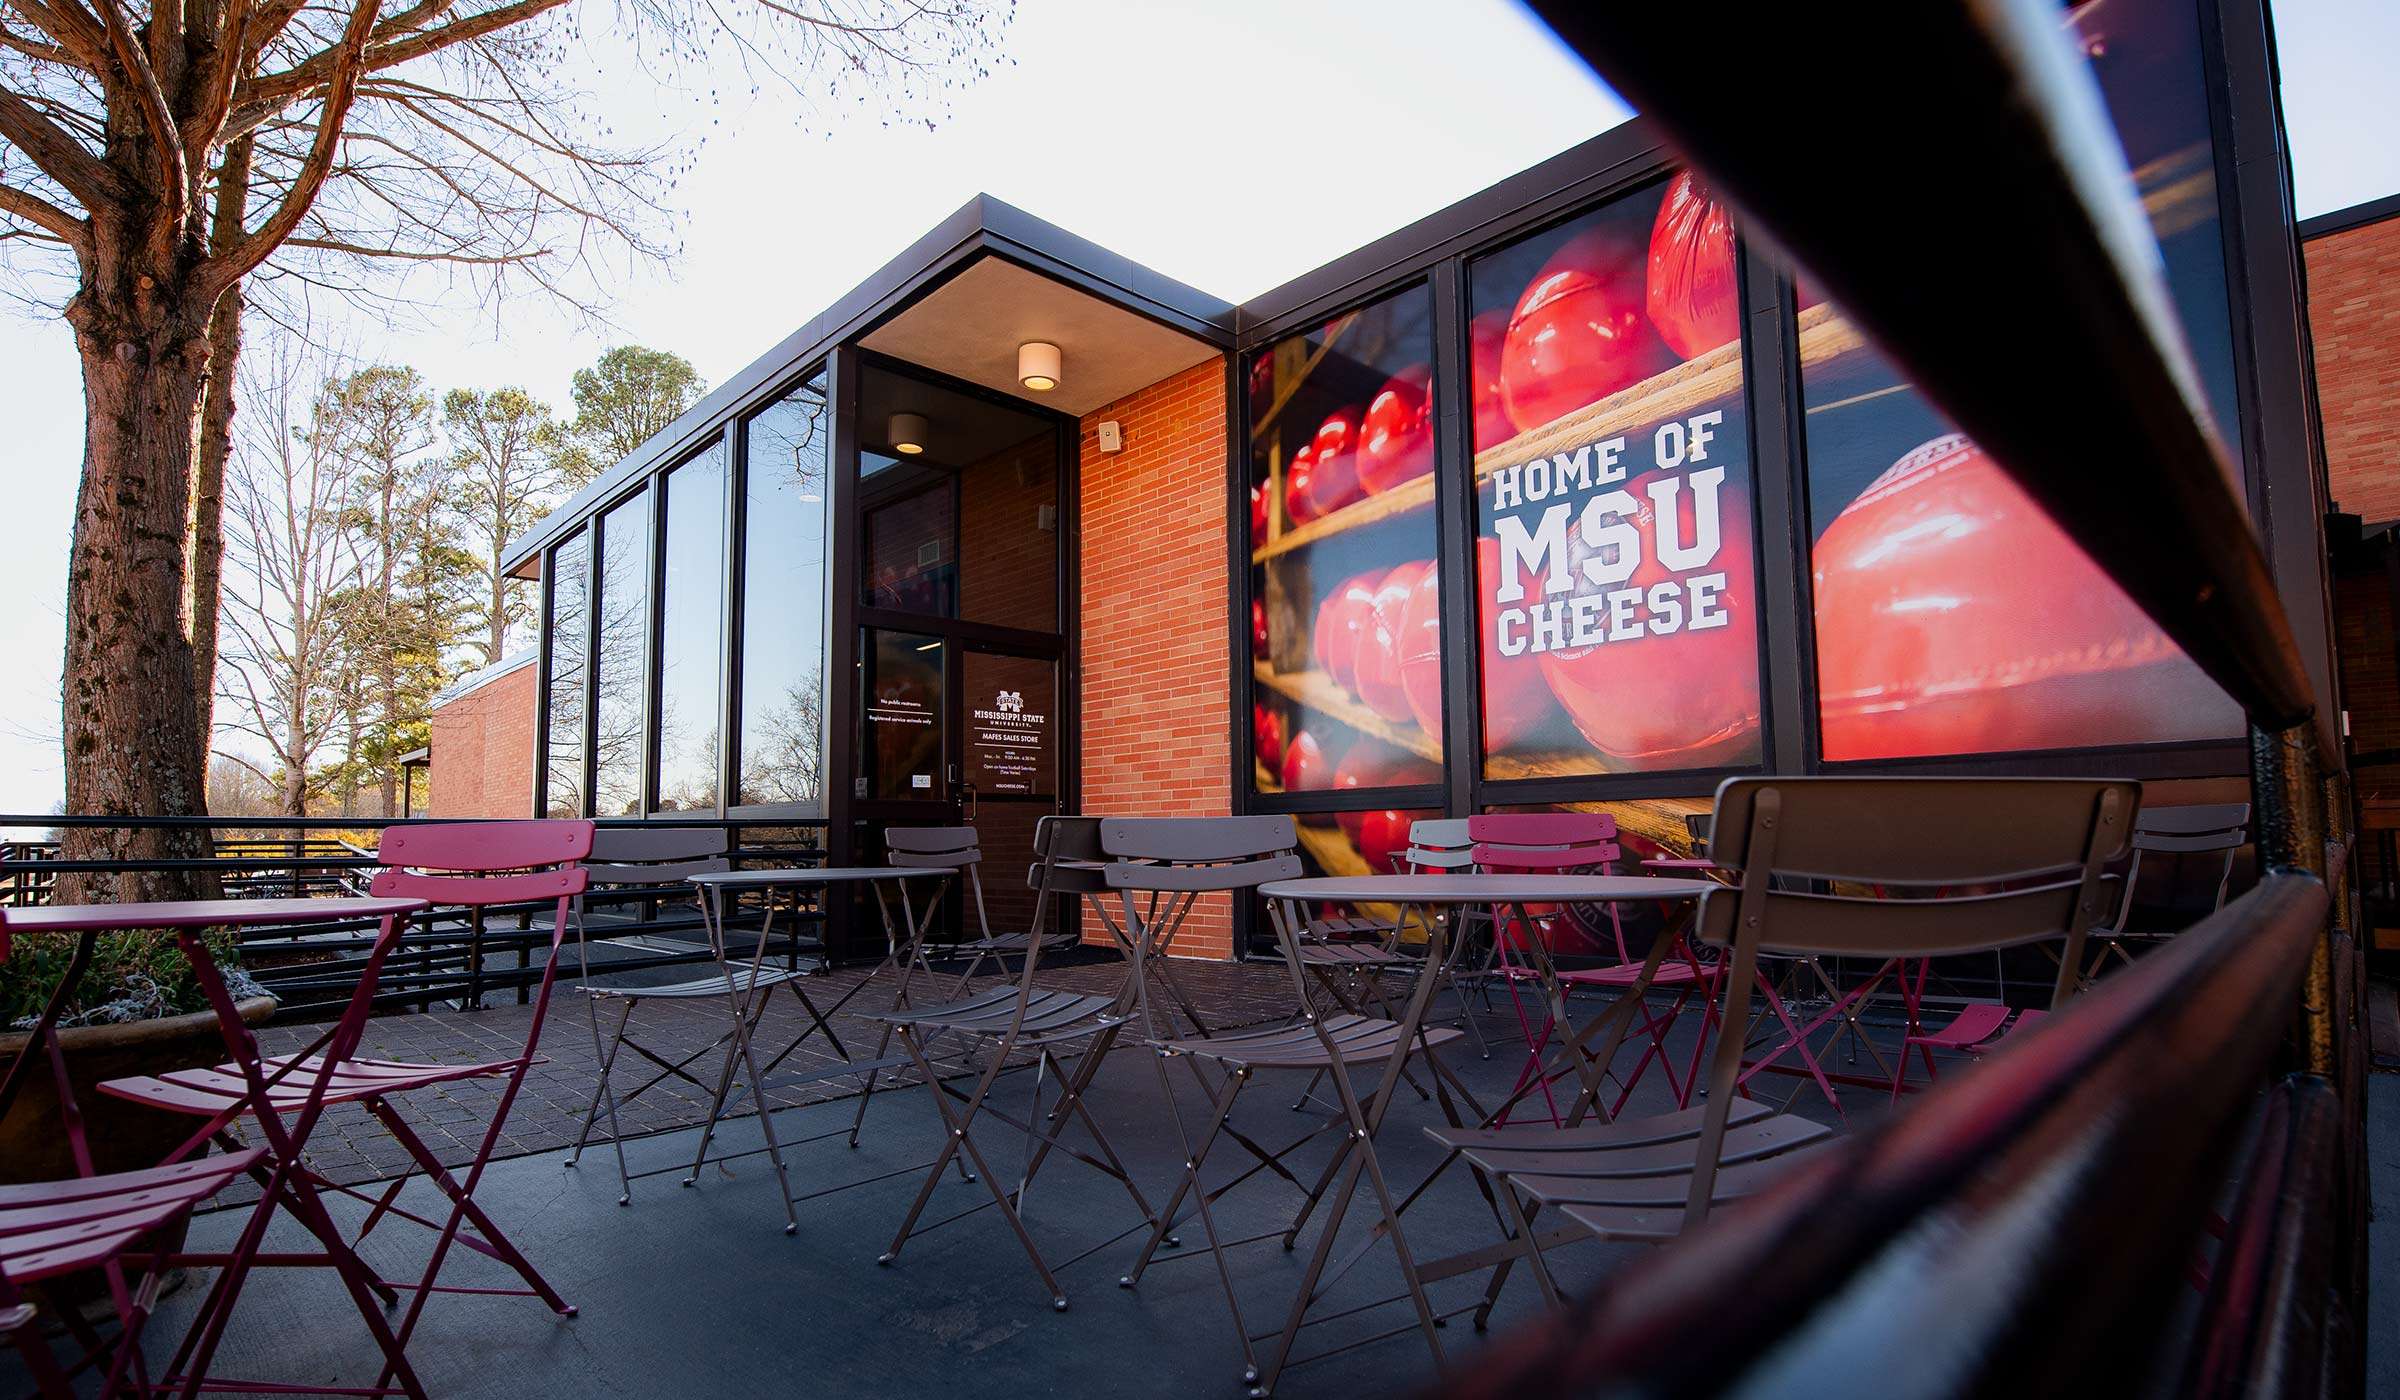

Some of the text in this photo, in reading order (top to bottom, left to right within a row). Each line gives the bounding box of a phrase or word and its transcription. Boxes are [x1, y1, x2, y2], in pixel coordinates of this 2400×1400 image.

[1493, 410, 1723, 511] HOME OF
[1494, 465, 1726, 604] MSU
[1497, 572, 1728, 658] CHEESE
[869, 714, 892, 722] Registered
[922, 718, 932, 726] only
[974, 710, 1045, 723] MISSISSIPPI STATE
[982, 732, 1039, 743] MAFES SALES STORE
